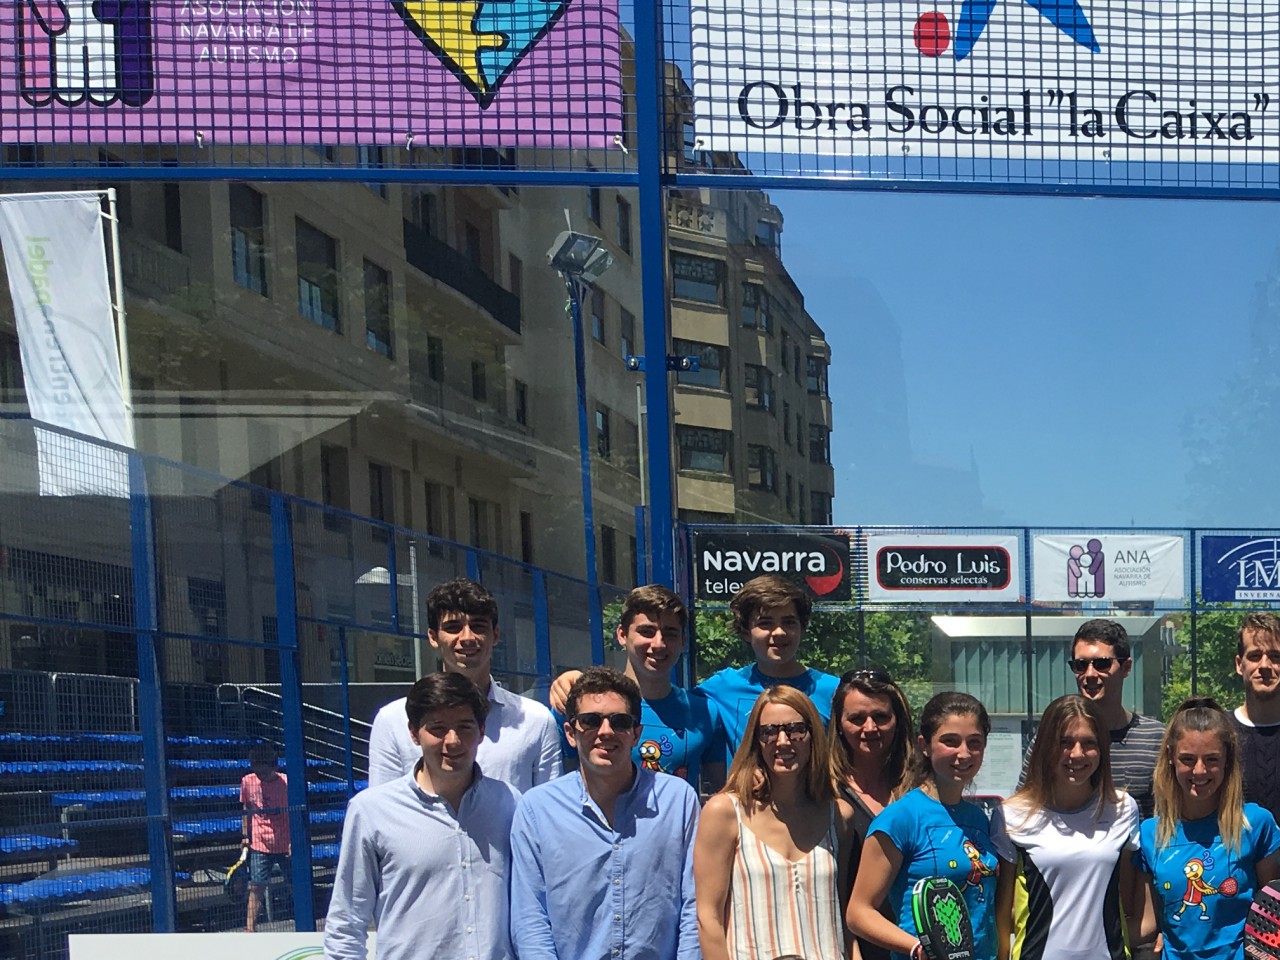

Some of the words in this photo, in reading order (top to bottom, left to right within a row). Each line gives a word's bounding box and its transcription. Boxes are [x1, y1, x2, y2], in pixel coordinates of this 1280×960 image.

[180, 22, 281, 38] NAVARRA
[287, 23, 314, 40] DE
[199, 46, 298, 64] AUTISMO
[738, 80, 872, 133] Obra
[884, 85, 1034, 138] Social
[703, 550, 826, 573] Navarra
[886, 551, 947, 574] Pedro
[957, 552, 1001, 574] Luis
[1114, 550, 1151, 564] ANA
[900, 576, 948, 585] conservas
